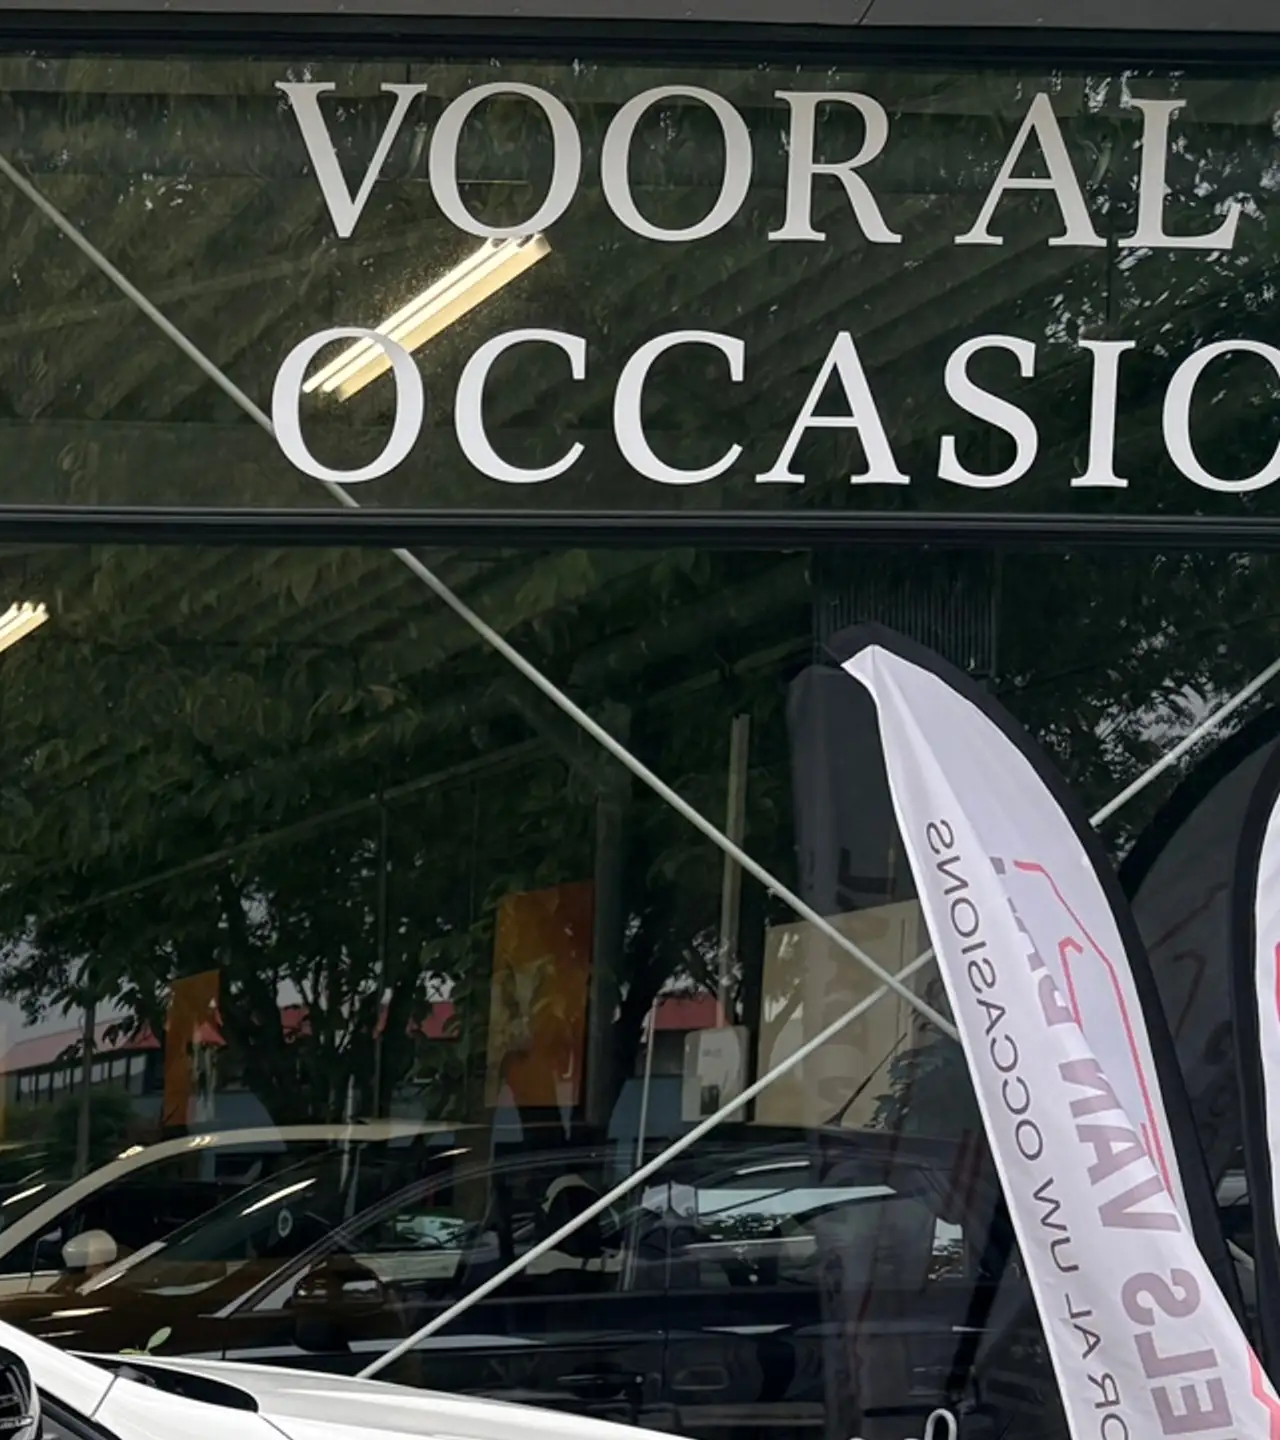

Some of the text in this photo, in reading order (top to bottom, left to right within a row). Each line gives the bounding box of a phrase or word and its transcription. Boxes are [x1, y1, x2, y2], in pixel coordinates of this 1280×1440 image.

[275, 80, 1242, 250] VOOR AL
[271, 326, 1280, 492] OCCASIO
